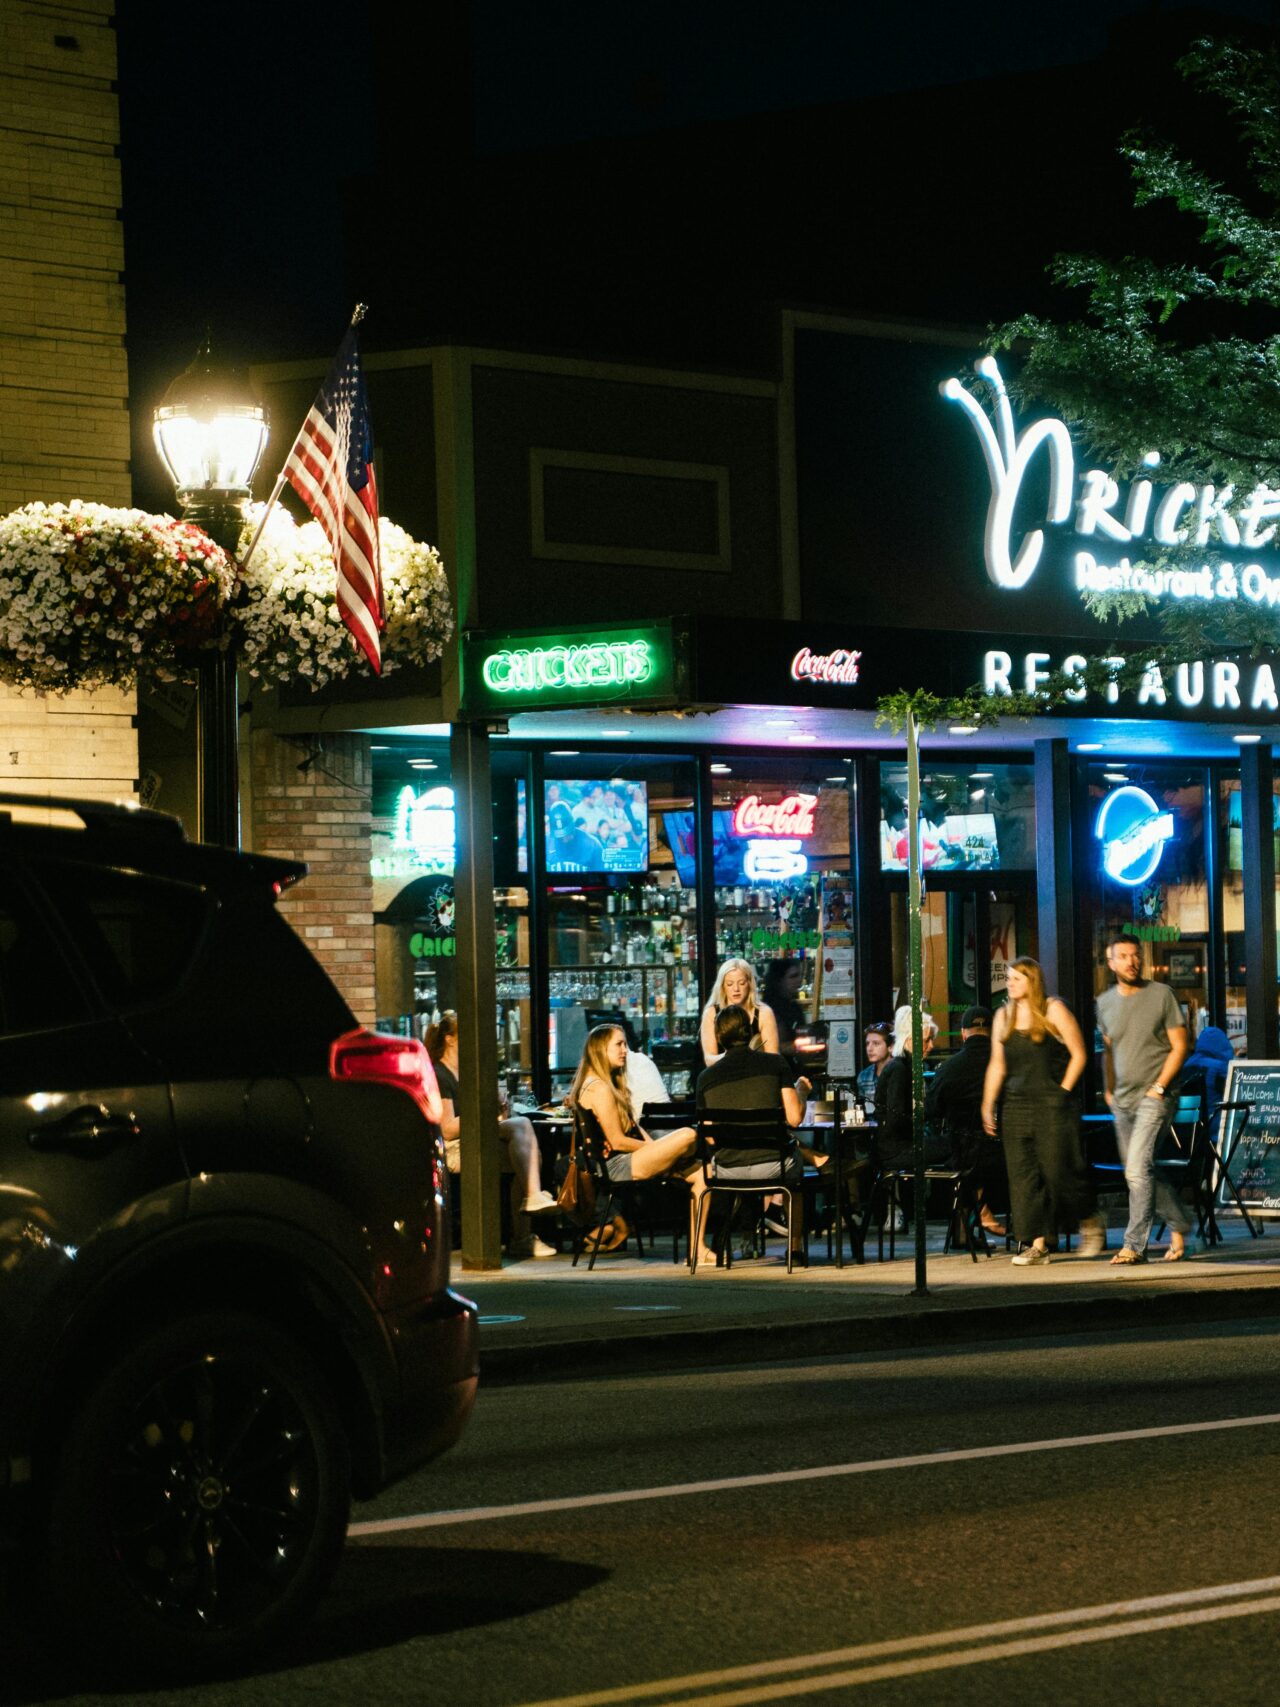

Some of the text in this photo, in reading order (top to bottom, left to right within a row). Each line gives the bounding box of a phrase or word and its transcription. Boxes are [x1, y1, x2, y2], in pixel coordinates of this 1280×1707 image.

[1216, 562, 1238, 597] &
[482, 640, 652, 691] CRICKETS
[791, 647, 861, 684] Coca-Cola
[734, 795, 818, 836] Coca-Cola
[965, 835, 984, 849] 424
[1240, 1085, 1274, 1100] Welcome
[1237, 1129, 1259, 1149] appy
